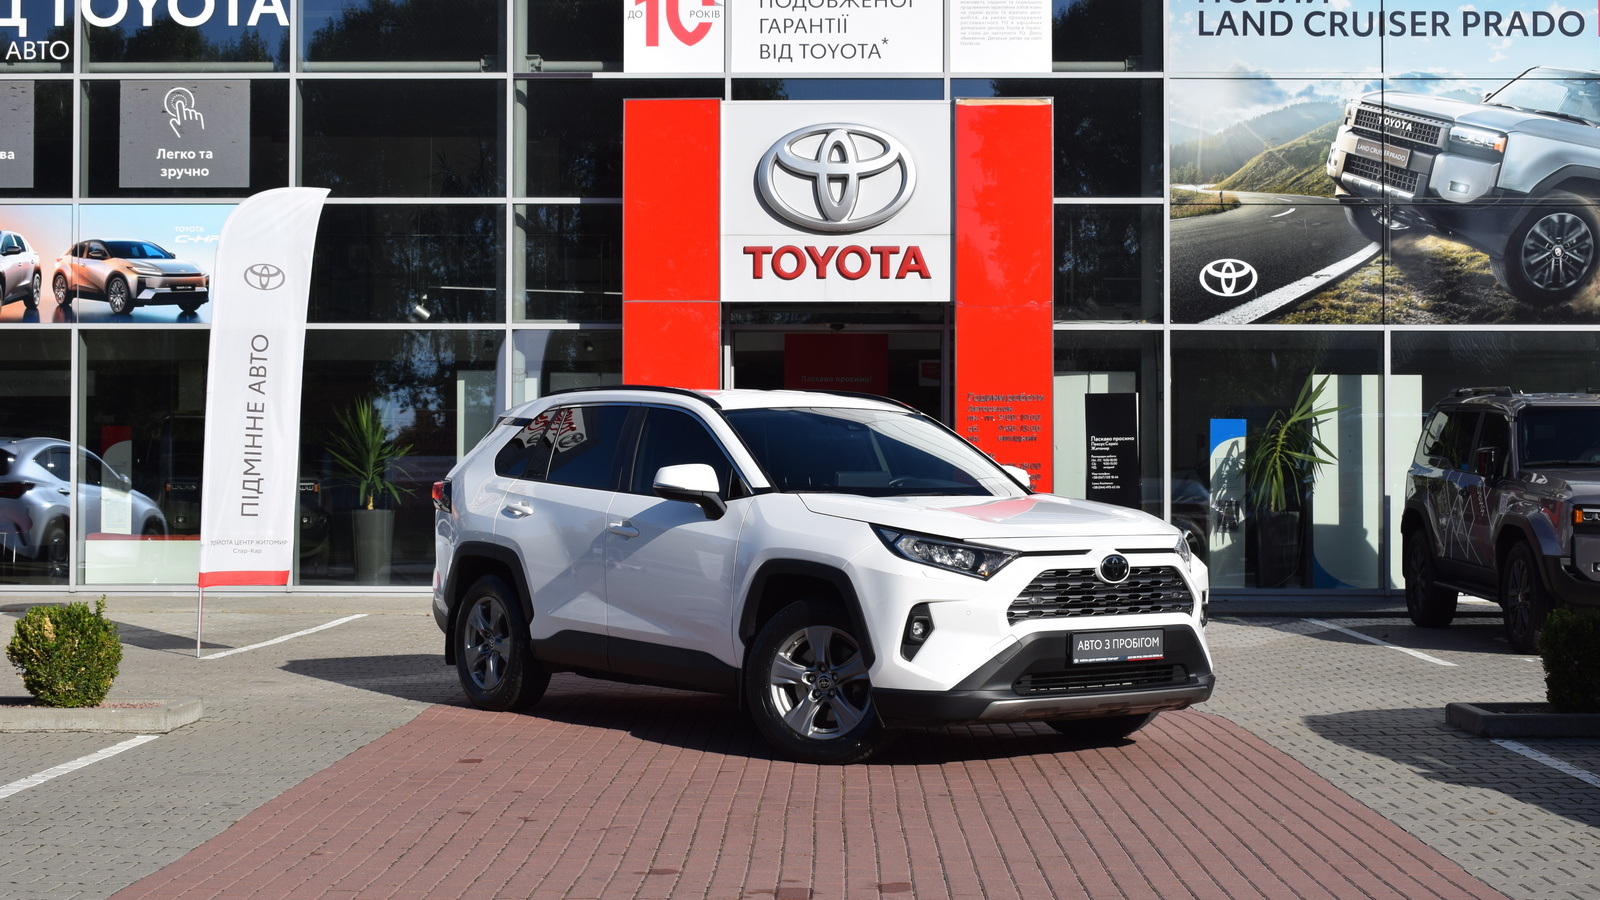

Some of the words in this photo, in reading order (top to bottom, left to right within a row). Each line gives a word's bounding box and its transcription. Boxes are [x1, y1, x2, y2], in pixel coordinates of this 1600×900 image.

[627, 10, 643, 19] ДО
[689, 9, 720, 18] РОКІВ
[759, 14, 849, 34] ГАРАНТІЇ
[1198, 10, 1293, 37] LAND
[1303, 10, 1451, 37] CRUISER
[1462, 10, 1585, 37] PRADO
[5, 41, 69, 60] АВТО
[759, 44, 793, 63] ВІД
[156, 148, 196, 161] Легко
[199, 150, 213, 160] та
[1357, 143, 1370, 152] LAND
[160, 167, 210, 180] зручно
[742, 245, 932, 281] TOYOTA
[248, 334, 270, 395] АВТО
[835, 376, 872, 384] просимо!
[967, 393, 1005, 403] Години
[1005, 393, 1044, 403] роботи
[998, 434, 1037, 442] вихідний
[240, 401, 266, 517] ПІДМІННЕ
[1077, 639, 1102, 651] АВТО
[1104, 639, 1110, 650] З
[1112, 637, 1159, 649] ПРОБІГОМ
